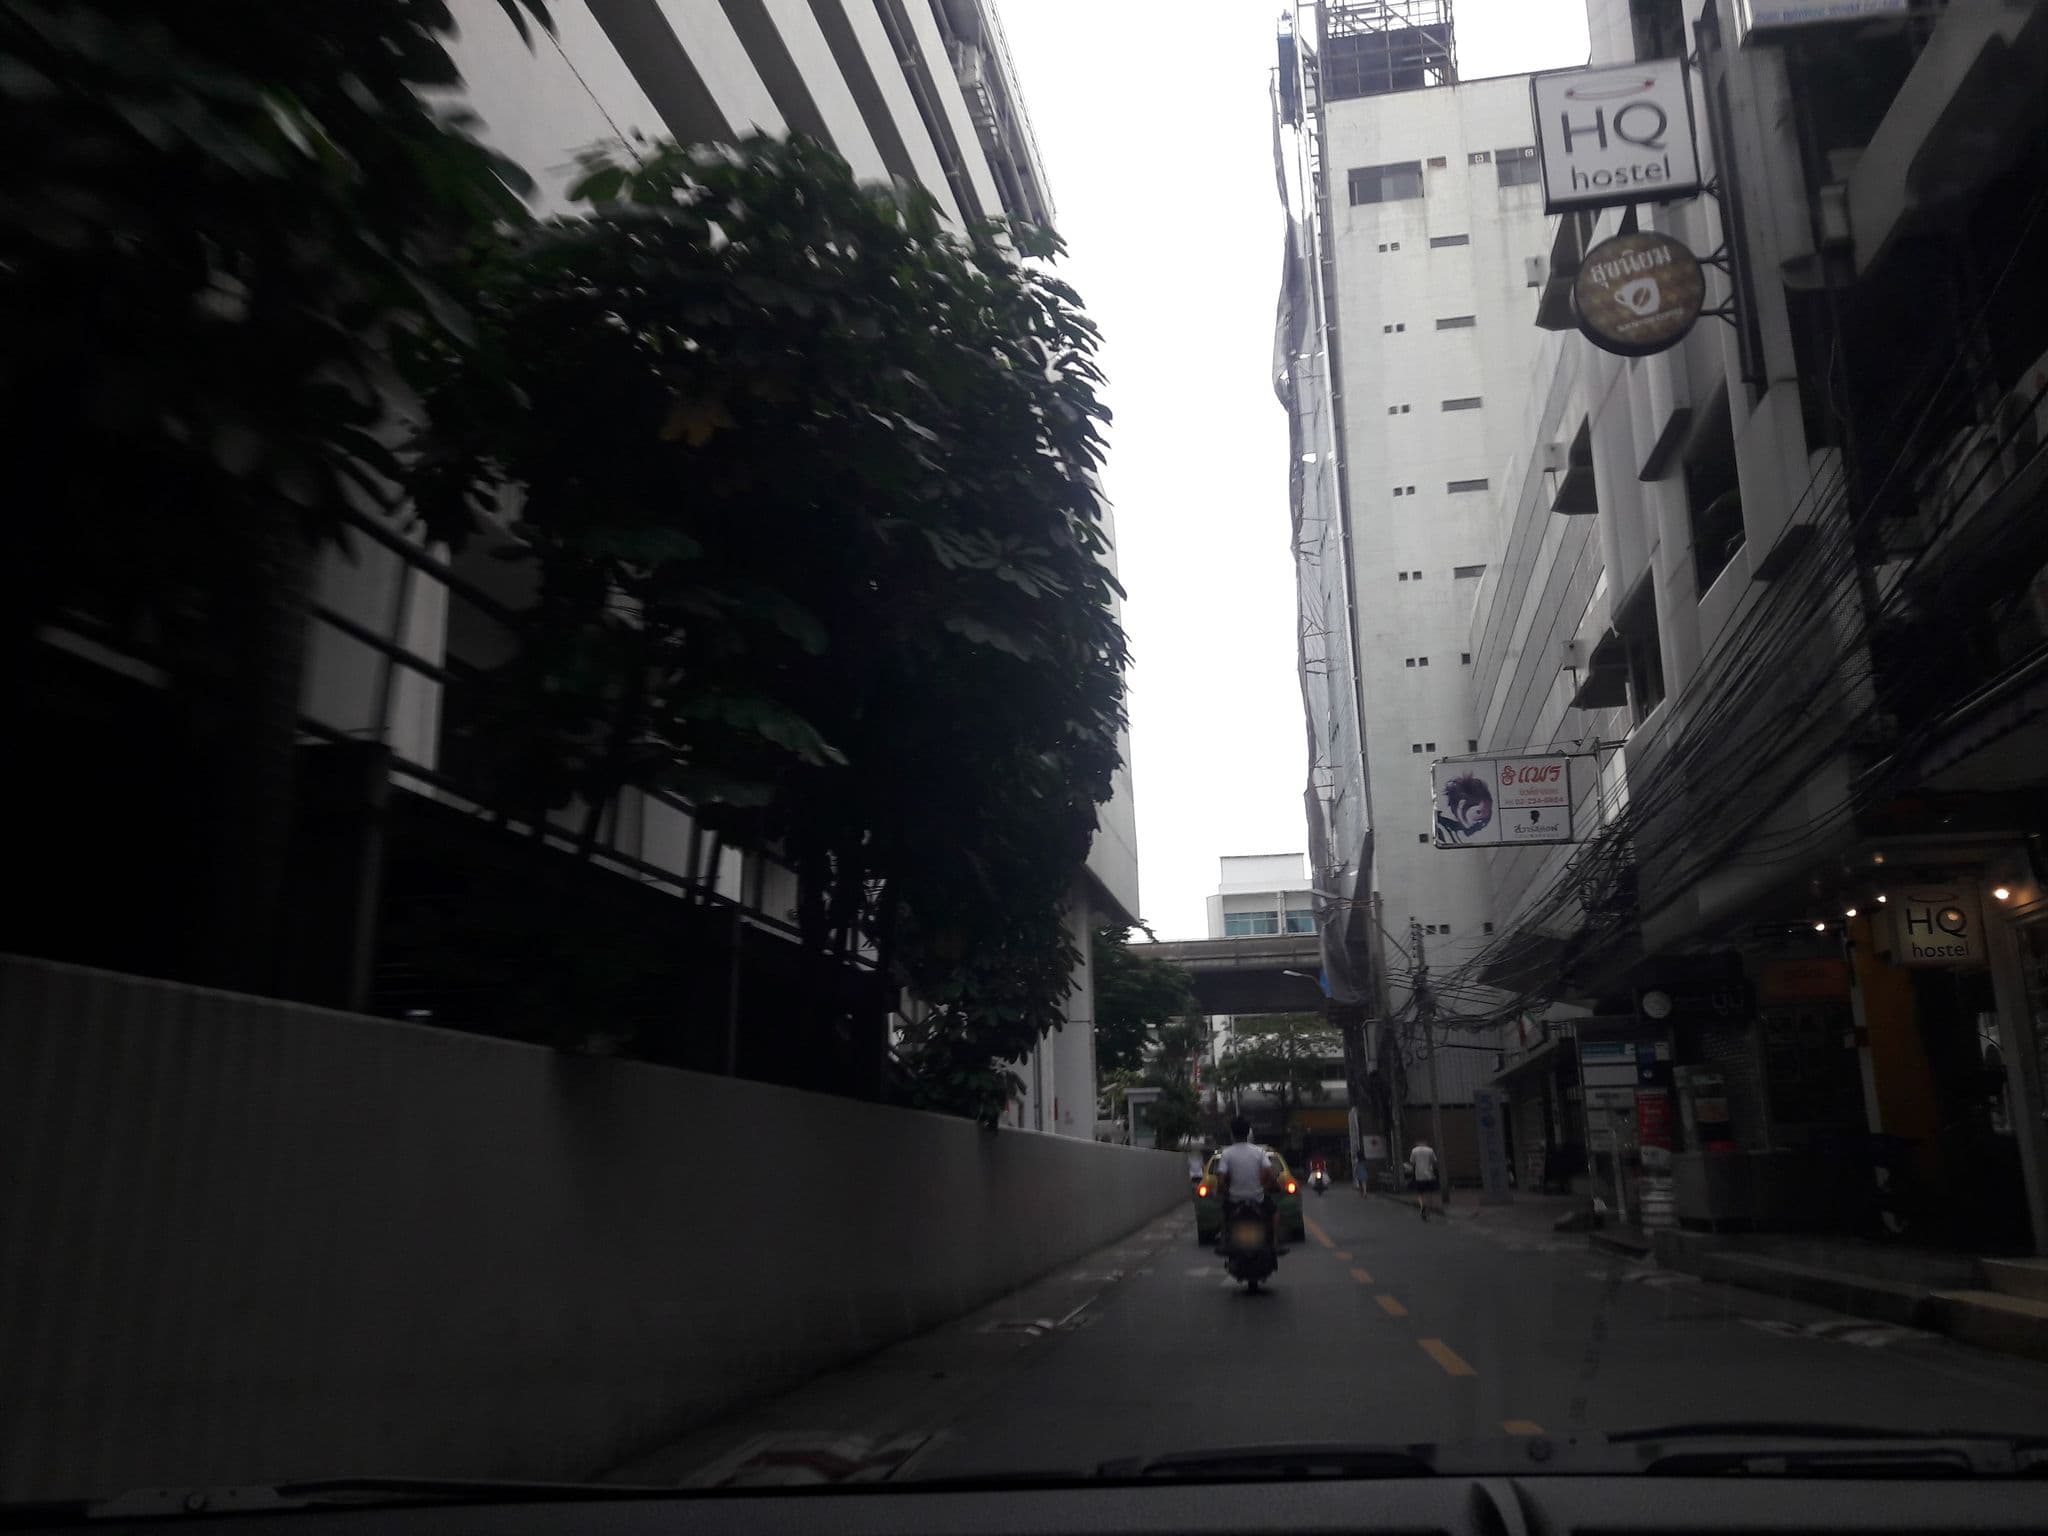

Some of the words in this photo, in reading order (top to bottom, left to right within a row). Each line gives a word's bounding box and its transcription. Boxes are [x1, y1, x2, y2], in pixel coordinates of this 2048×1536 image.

[1561, 101, 1667, 153] HQ
[1572, 154, 1670, 191] hostel
[1906, 907, 1968, 938] HQ
[1912, 942, 1969, 959] hostel
